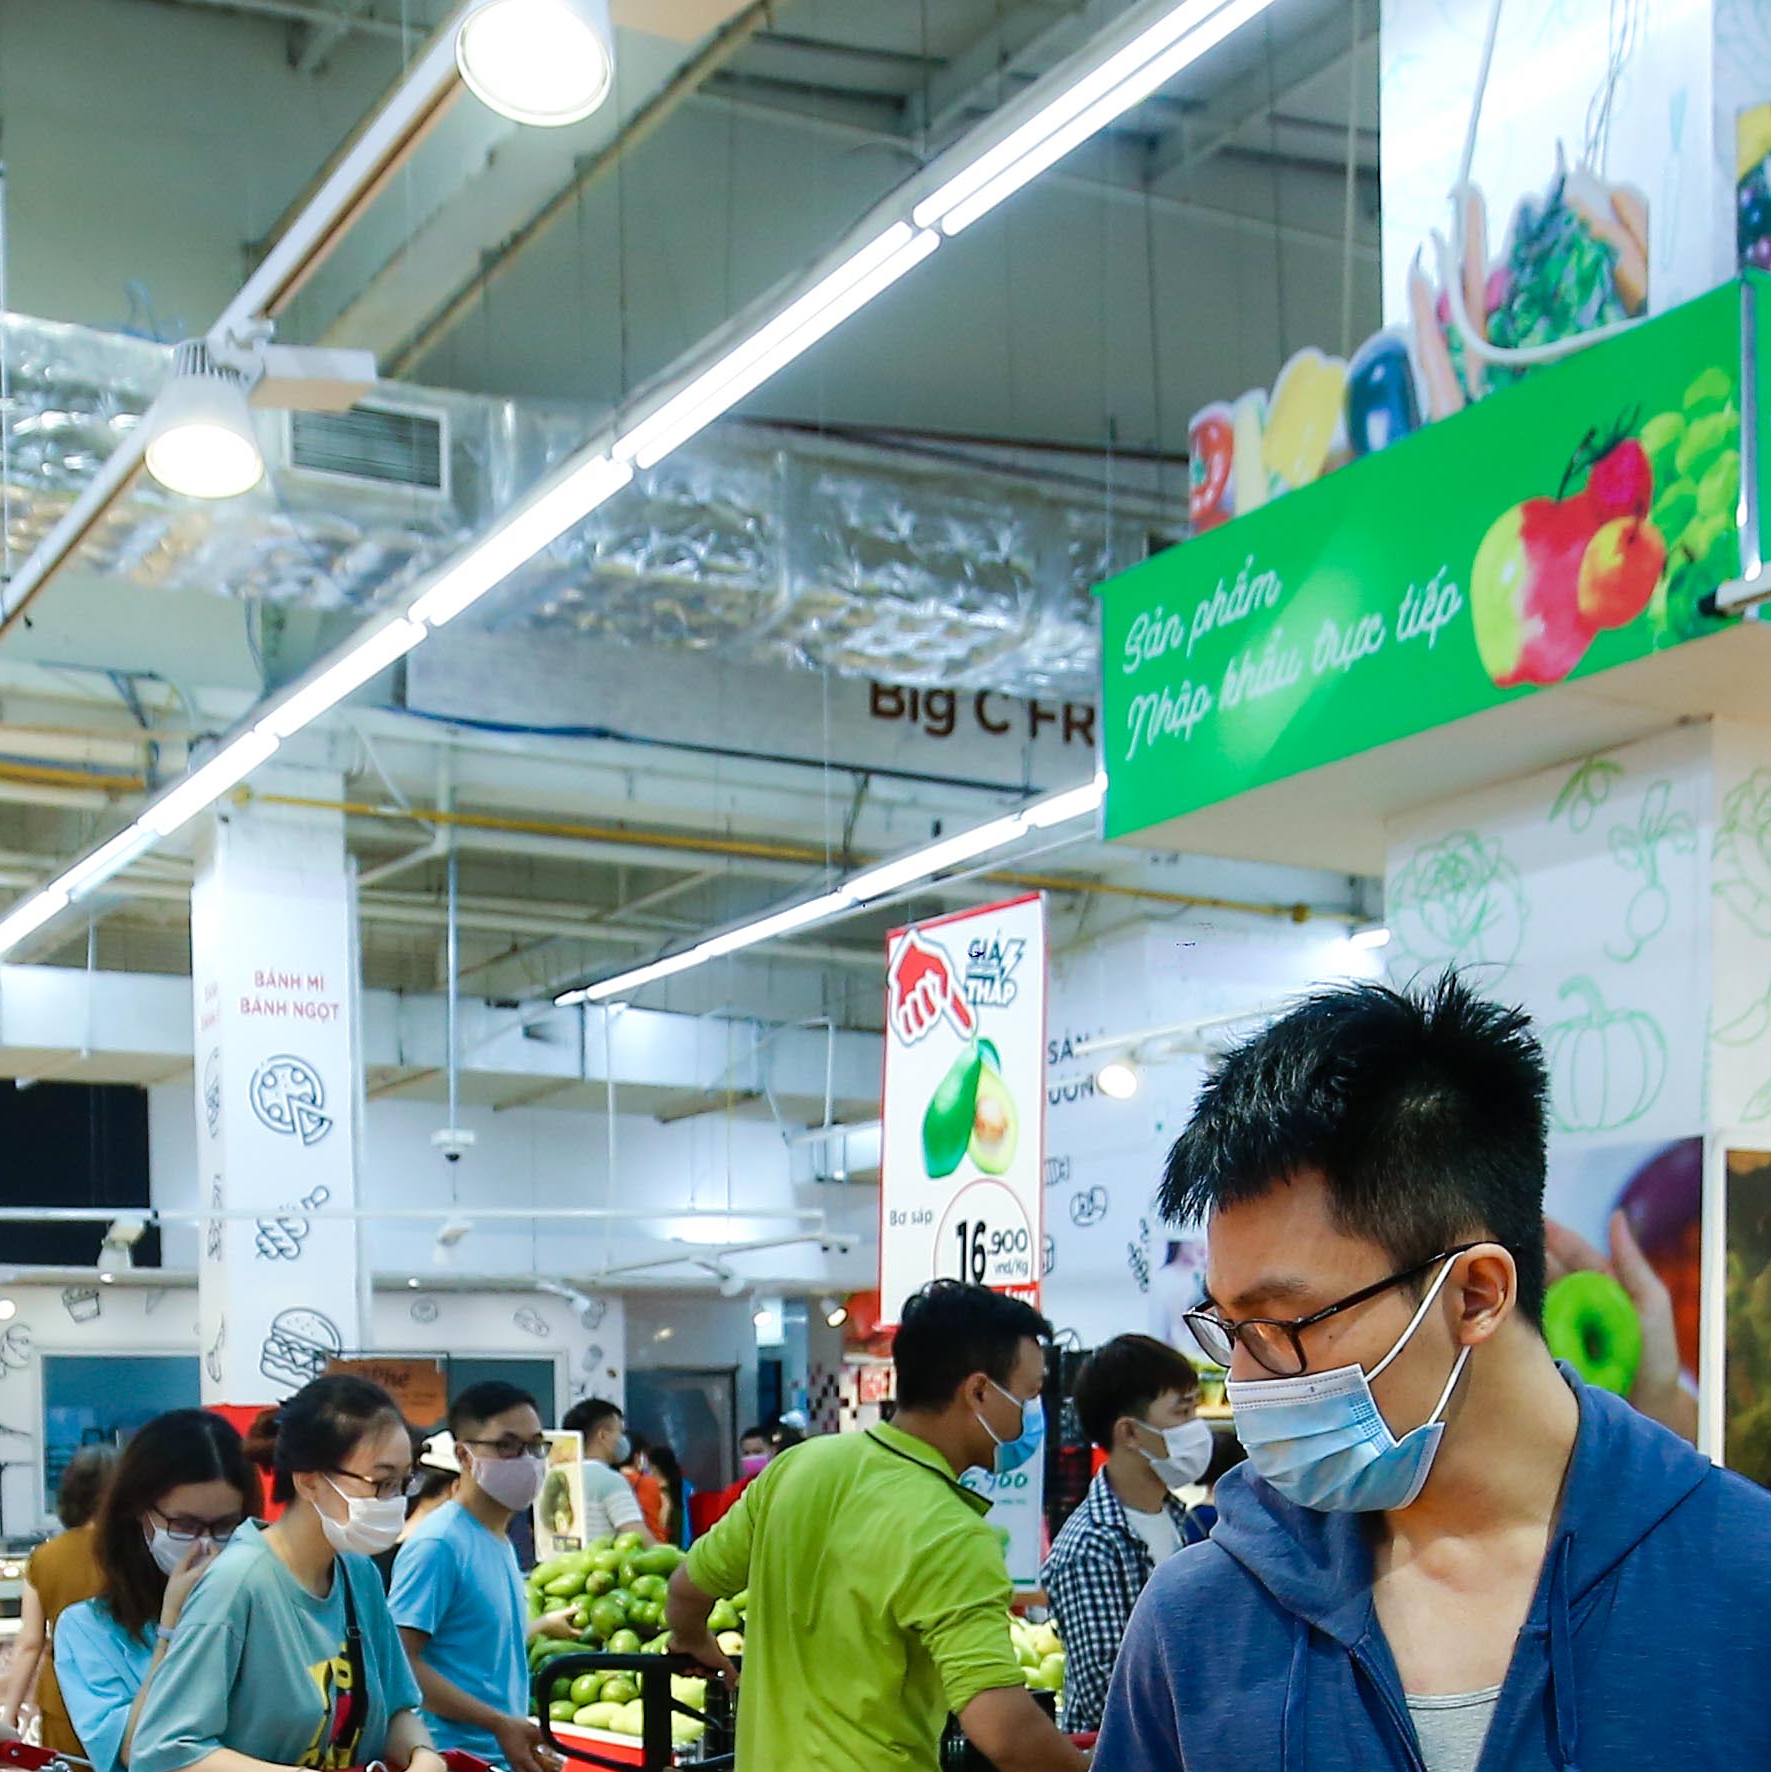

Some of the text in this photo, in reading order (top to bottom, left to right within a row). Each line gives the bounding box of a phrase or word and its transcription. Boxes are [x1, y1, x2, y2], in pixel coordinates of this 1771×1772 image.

[1122, 553, 1283, 674] Sản phẩm
[1125, 564, 1463, 762] Nhập khẩu trực tiếp
[869, 679, 956, 737] Big
[974, 689, 1012, 736] C
[255, 967, 301, 991] BÁNH
[240, 993, 287, 1017] BÁNH
[293, 1001, 340, 1025] NGỌT
